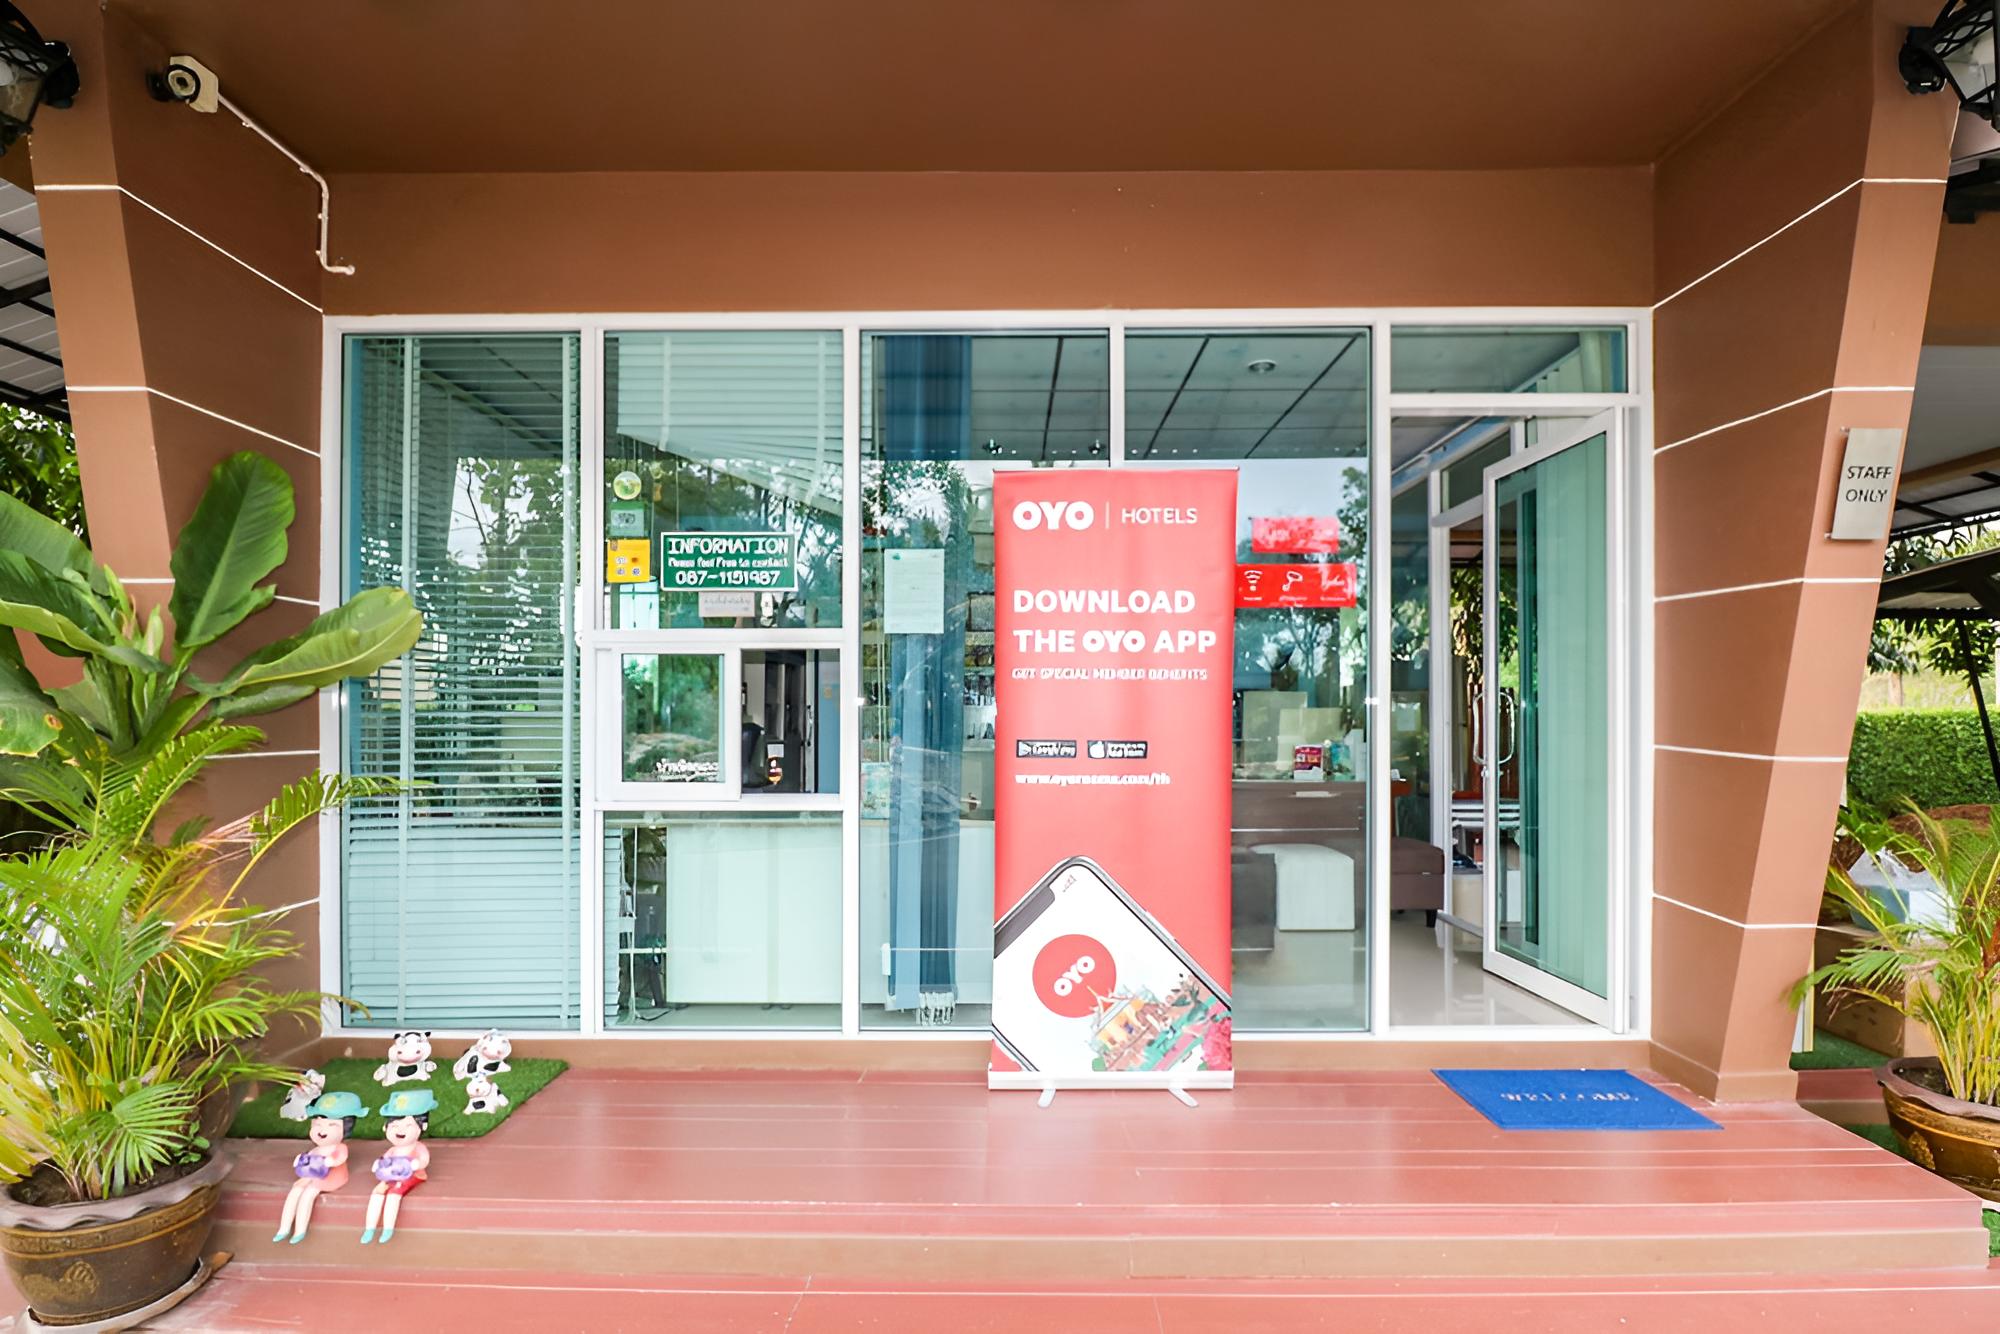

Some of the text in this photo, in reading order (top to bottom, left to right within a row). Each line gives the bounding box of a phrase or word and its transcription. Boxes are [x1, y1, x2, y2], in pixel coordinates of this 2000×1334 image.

[1847, 466, 1893, 480] STAFF
[1845, 488, 1888, 503] ONLY
[1012, 500, 1198, 530] OYO HOTELS
[667, 536, 789, 555] INFORMATION
[1013, 589, 1196, 614] DOWNLOAD
[1013, 629, 1217, 653] THE OYO APP
[1053, 955, 1096, 997] OYO
